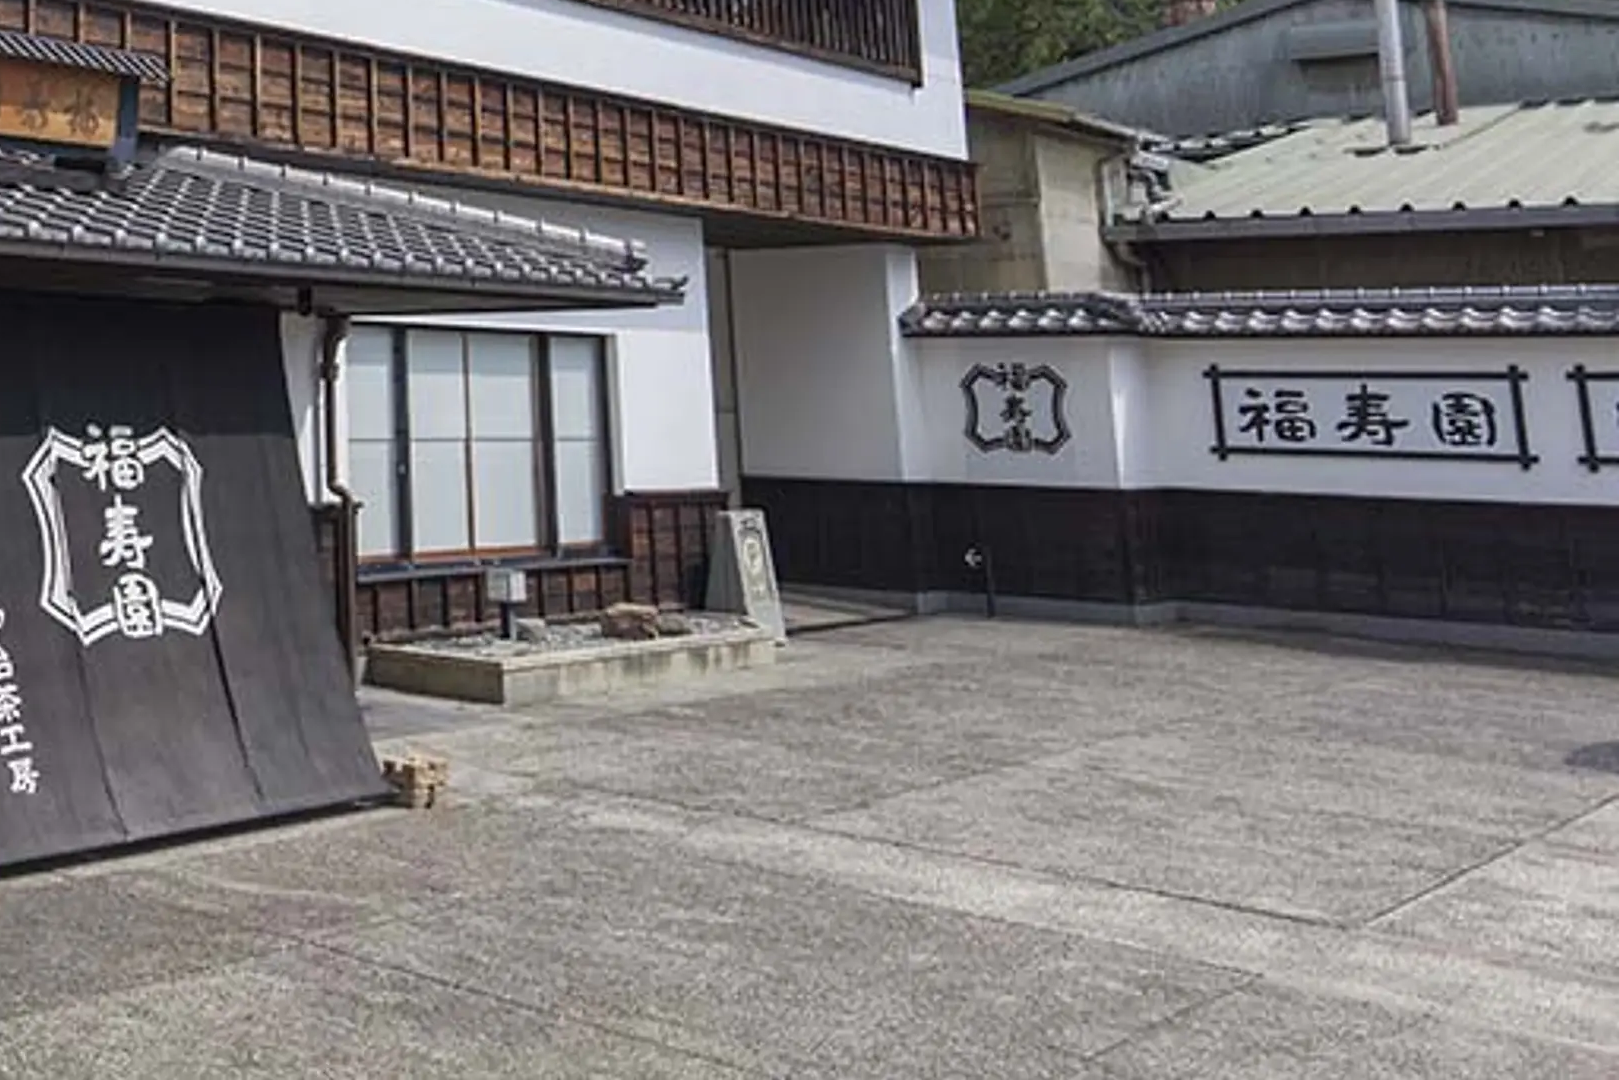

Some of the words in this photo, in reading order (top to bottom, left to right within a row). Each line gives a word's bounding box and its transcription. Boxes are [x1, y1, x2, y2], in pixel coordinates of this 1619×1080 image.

[1237, 382, 1497, 447] 福寿園
[80, 424, 164, 639] 福寿園
